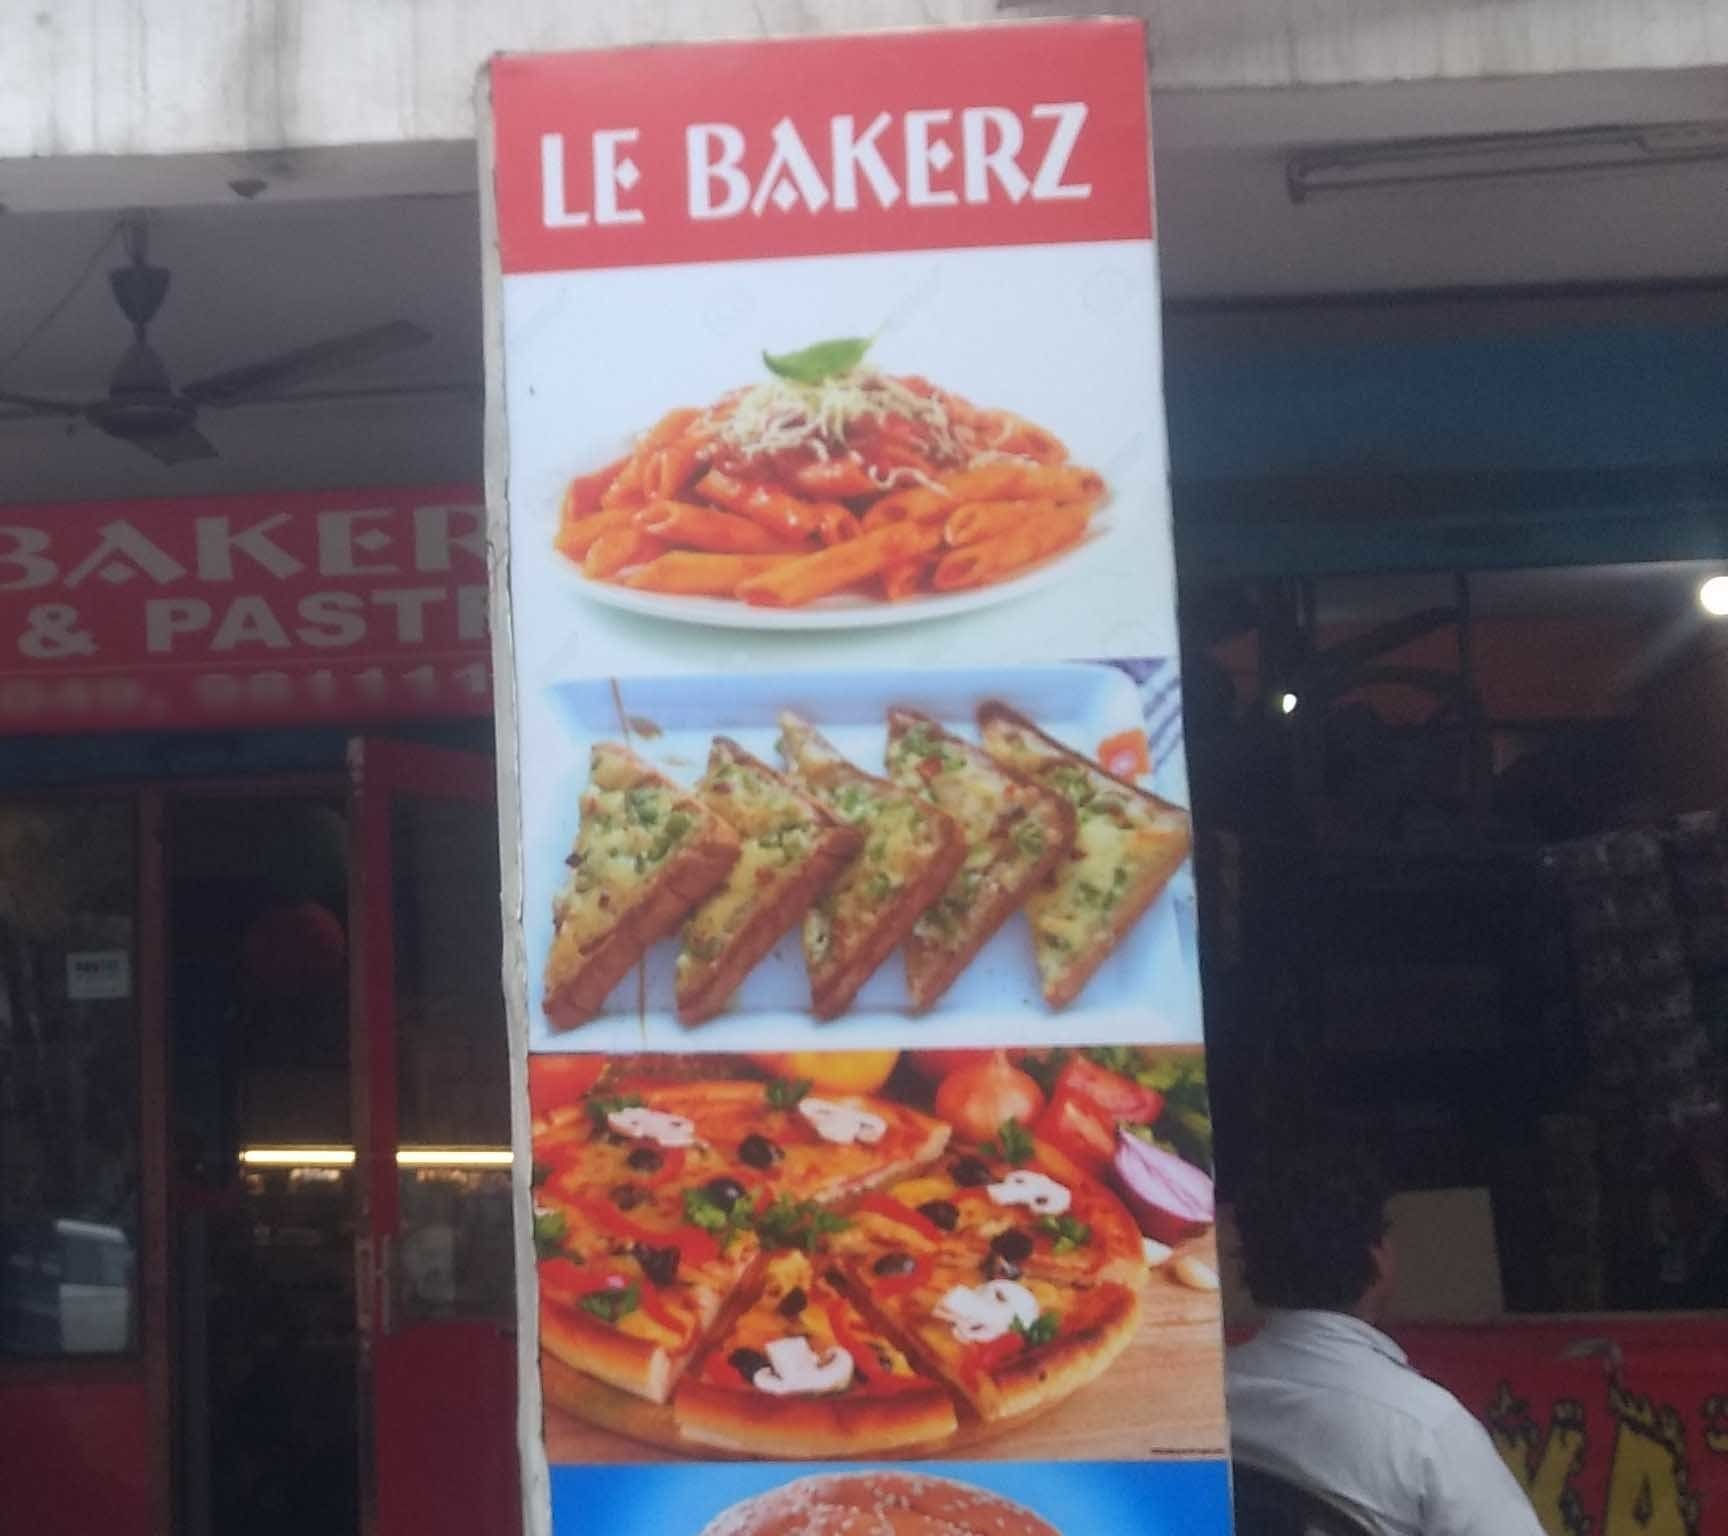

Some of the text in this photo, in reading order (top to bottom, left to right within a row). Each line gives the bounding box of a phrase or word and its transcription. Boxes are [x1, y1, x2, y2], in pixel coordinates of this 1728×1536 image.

[541, 101, 1092, 229] LE BAKERZ
[17, 604, 97, 661] &
